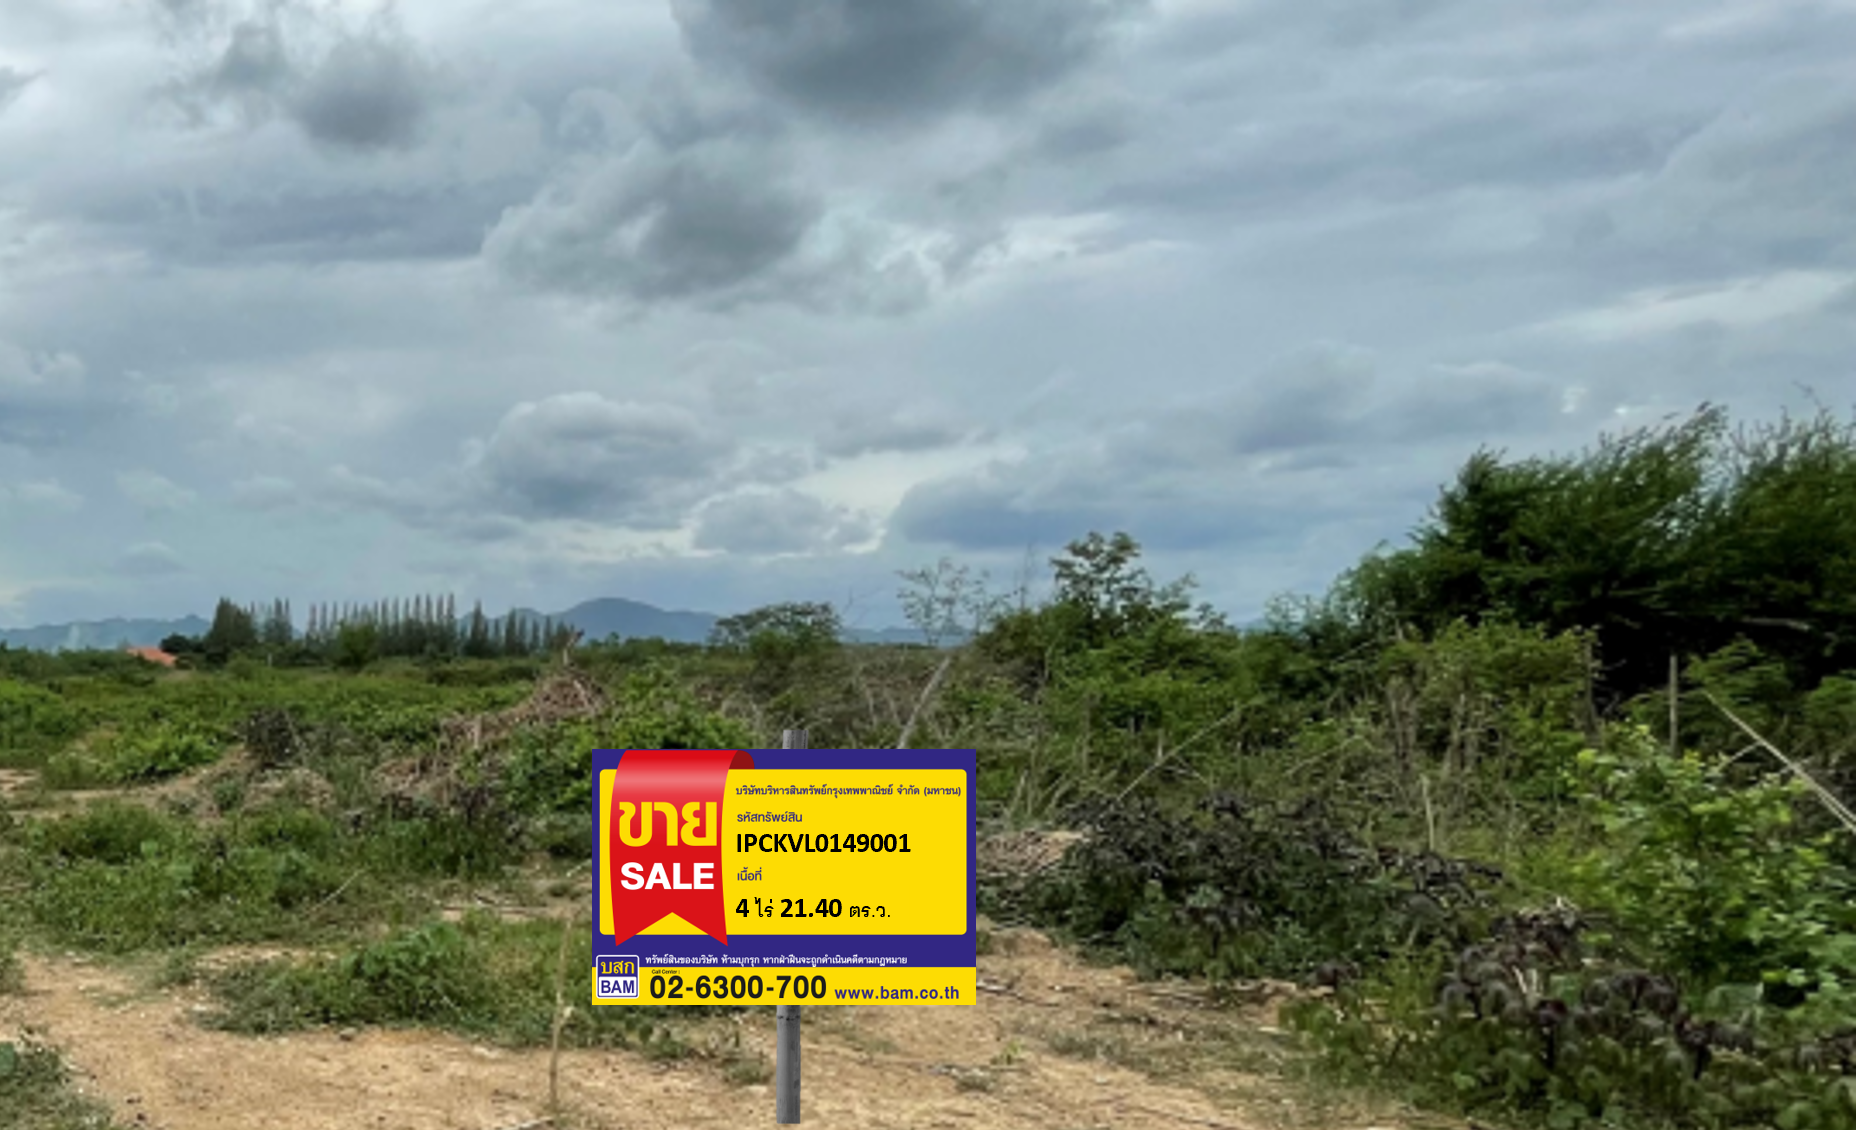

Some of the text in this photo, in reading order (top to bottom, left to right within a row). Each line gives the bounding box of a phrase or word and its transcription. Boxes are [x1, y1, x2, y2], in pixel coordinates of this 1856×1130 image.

[736, 783, 962, 799] บริษัทบริหารสินทรัพย์กรุงเทพพาณิชย์ จำกัด (มหาชน)
[619, 801, 717, 847] ขาย
[737, 811, 803, 823] รหัสทรัพย์สิน
[737, 834, 911, 853] IPCKVL0149001
[621, 862, 715, 890] SALE
[737, 866, 763, 881] เนื้อที่
[736, 897, 891, 918] 4 ไร่ 21.40 ตร.ว.
[600, 960, 635, 975] บสก
[645, 953, 718, 964] ทรัพย์สินของบริษัท
[721, 954, 760, 967] ห้ามบุกรุก
[601, 980, 635, 994] BAM
[650, 975, 826, 999] 02-6300-700
[834, 985, 960, 999] www.bam.co.th
